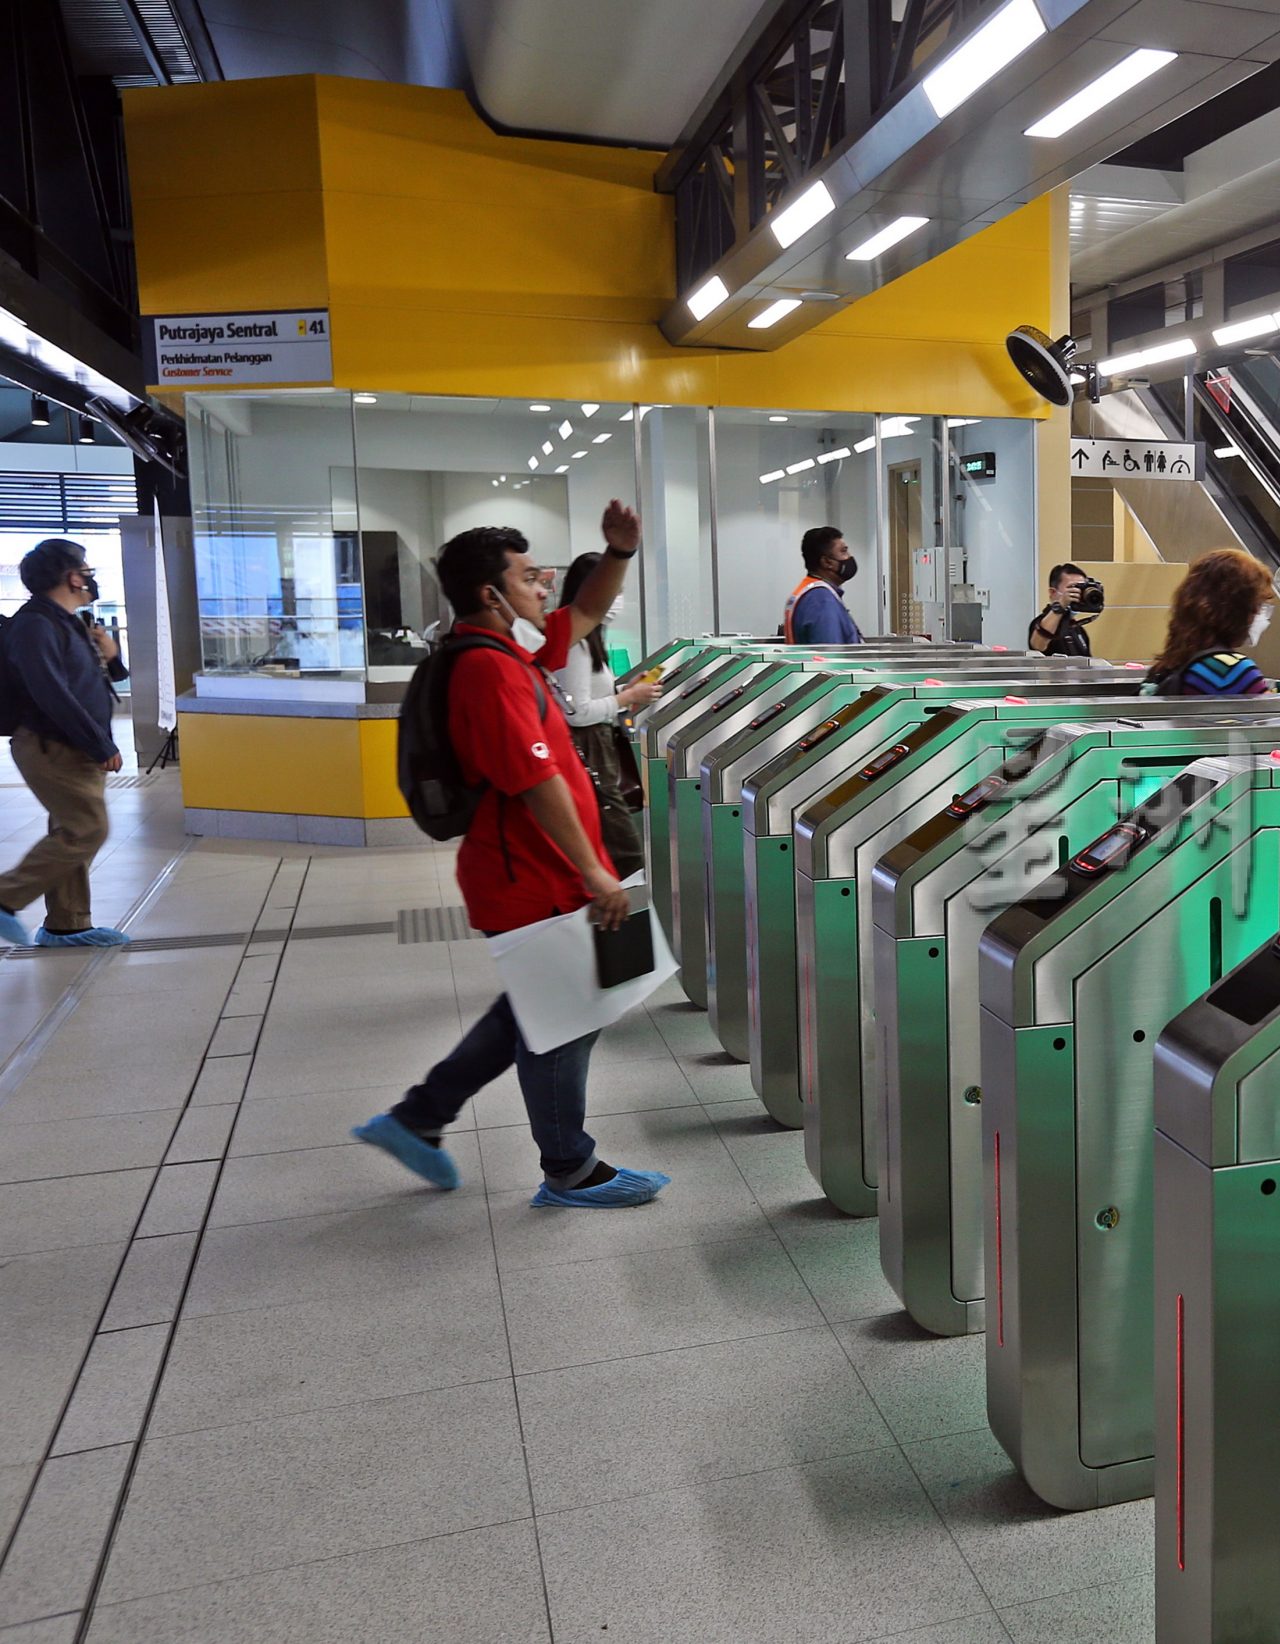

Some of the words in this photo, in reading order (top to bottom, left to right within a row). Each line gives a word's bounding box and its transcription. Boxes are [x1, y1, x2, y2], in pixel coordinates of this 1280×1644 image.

[159, 323, 224, 343] Putrajaya
[227, 320, 278, 338] Sentral
[309, 319, 326, 334] 41
[160, 353, 222, 365] Perkhidmatan
[224, 352, 272, 365] Pelanggan
[162, 367, 201, 377] Customer
[203, 367, 233, 377] Service
